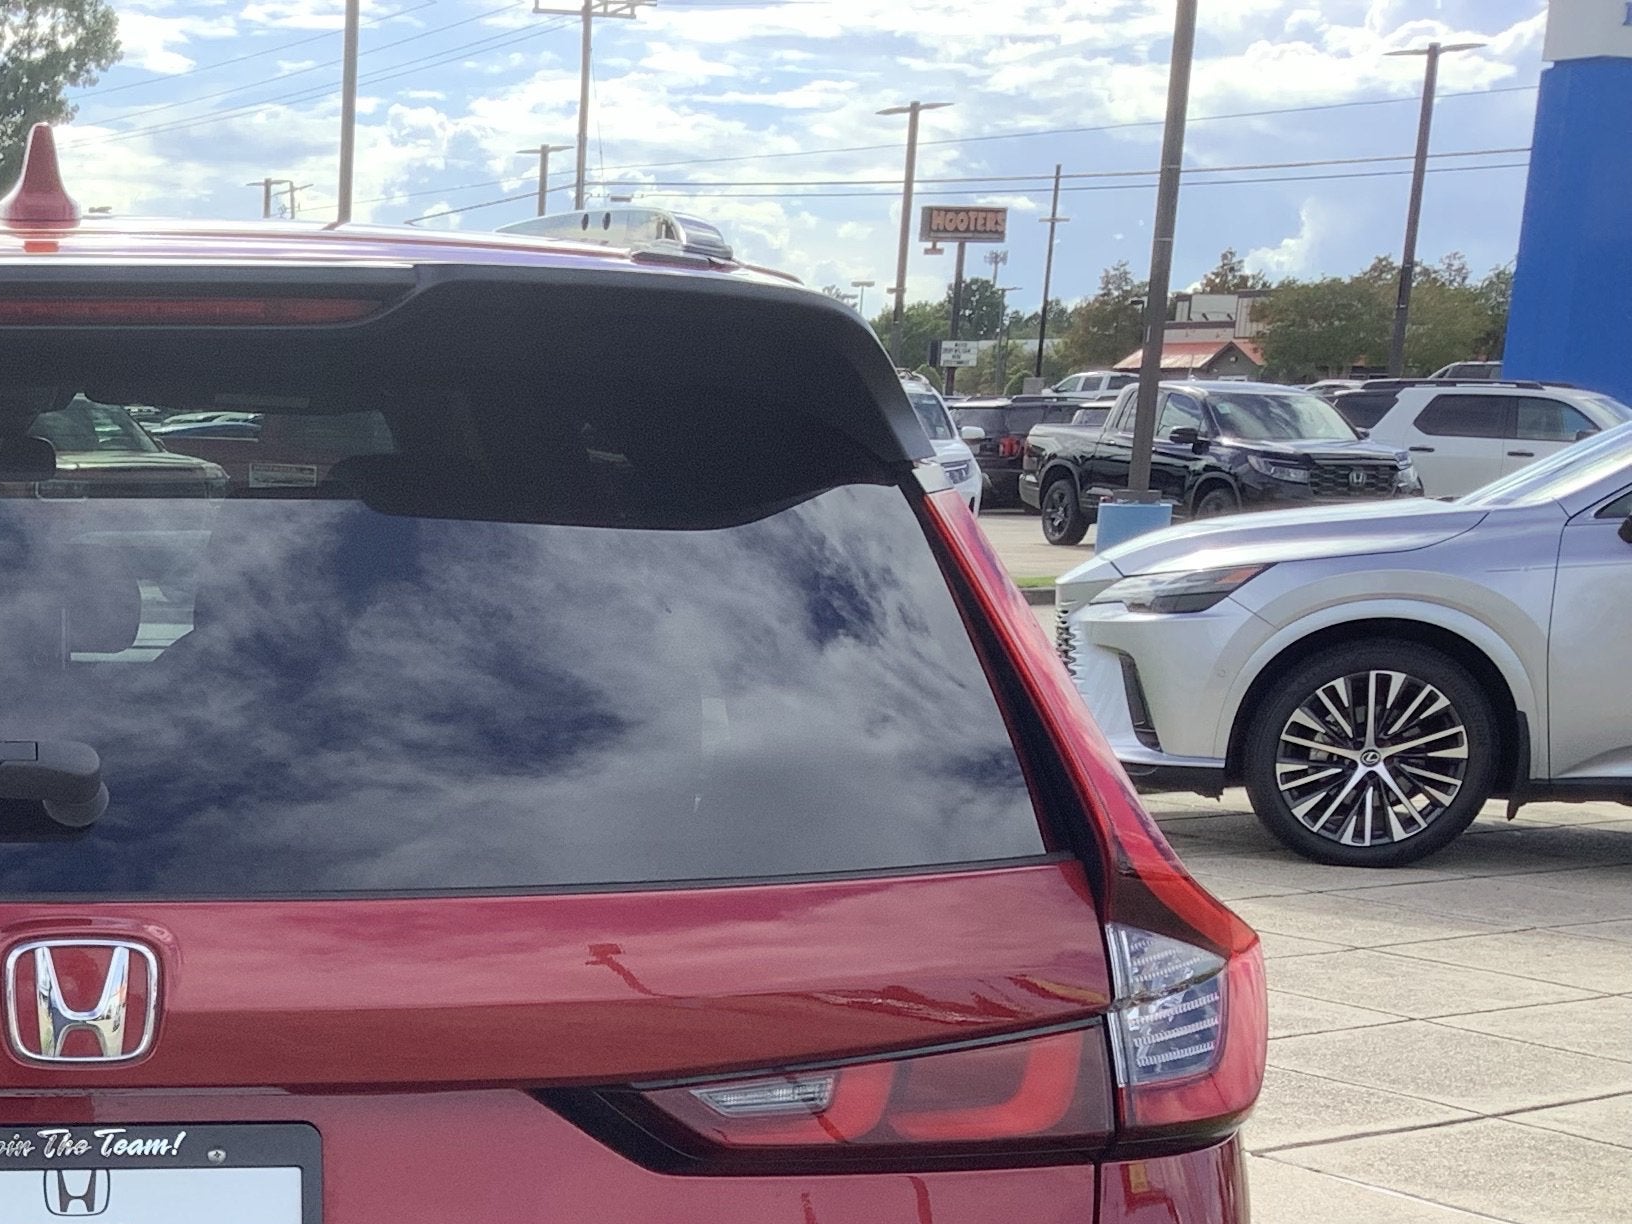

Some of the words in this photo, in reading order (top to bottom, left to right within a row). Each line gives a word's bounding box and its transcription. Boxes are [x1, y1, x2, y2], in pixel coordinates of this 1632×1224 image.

[931, 210, 1005, 232] HOOTERS
[36, 1128, 92, 1159] The
[93, 1128, 187, 1158] Team!
